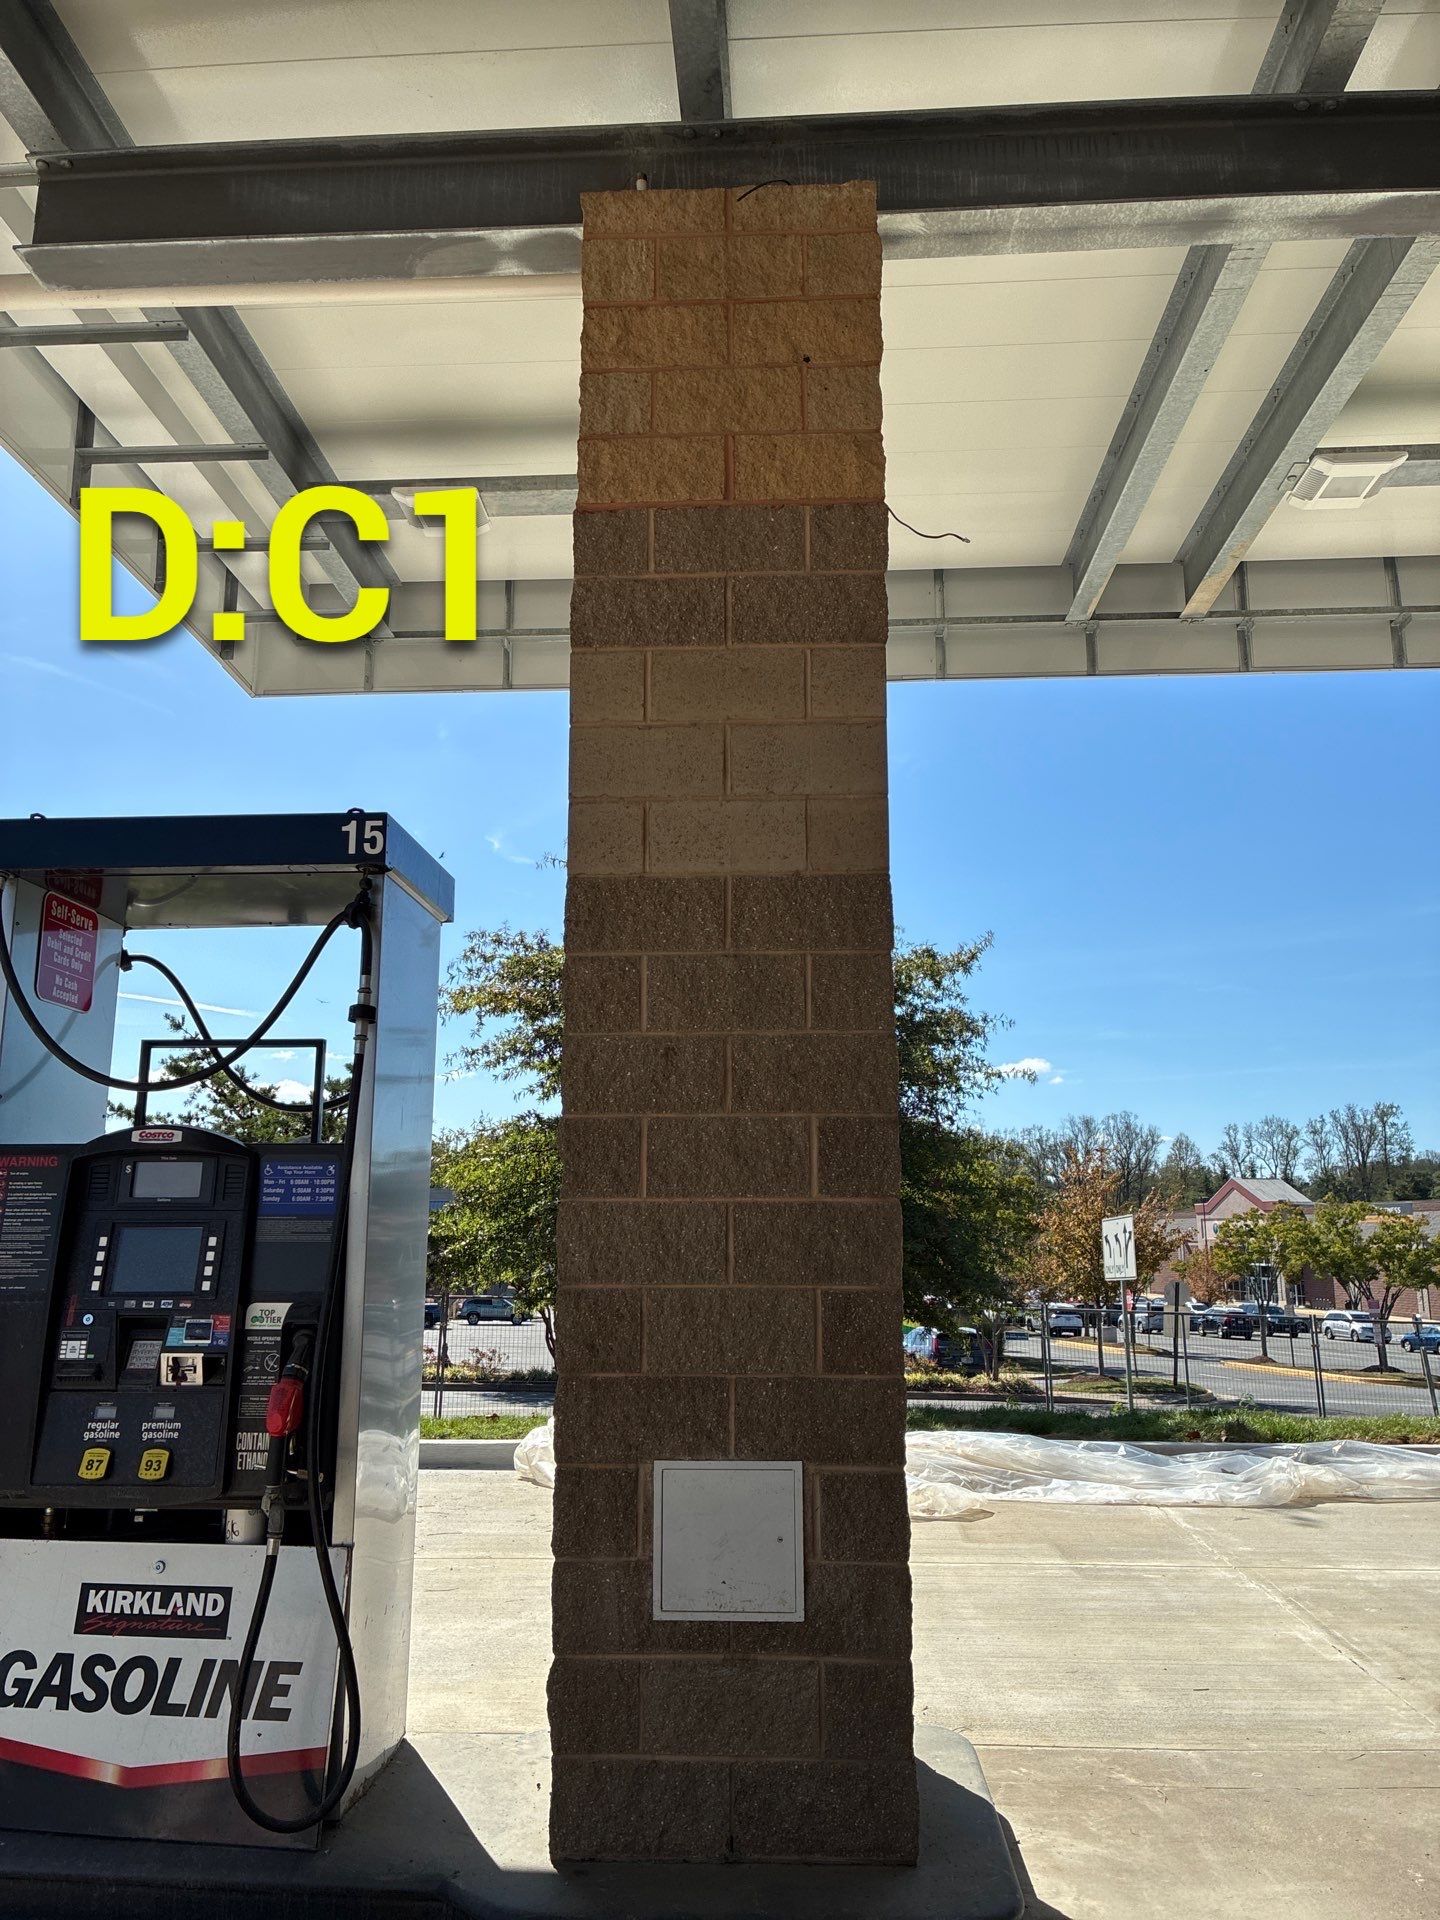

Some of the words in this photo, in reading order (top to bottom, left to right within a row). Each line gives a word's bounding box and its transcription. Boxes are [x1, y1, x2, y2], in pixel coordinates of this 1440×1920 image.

[341, 820, 384, 855] 15
[51, 900, 93, 931] Self-Serve
[58, 929, 83, 947] Selected
[47, 937, 62, 951] Debit
[63, 944, 73, 955] and
[75, 947, 92, 962] Credit
[53, 952, 69, 967] Cards
[70, 958, 83, 973] Only
[55, 973, 63, 987] No
[64, 977, 78, 991] Cash
[52, 986, 79, 1004] Accepted
[138, 1131, 175, 1139] COSTCO
[0, 1155, 58, 1168] WARNING
[259, 1309, 276, 1317] TOP
[265, 1316, 282, 1324] TIER
[87, 1420, 120, 1432] regular
[141, 1420, 182, 1432] premium
[83, 1430, 121, 1441] gasoline
[141, 1430, 179, 1442] gasoline
[236, 1432, 270, 1451] CONTAIN
[85, 1459, 104, 1472] 87
[144, 1459, 162, 1472] 93
[237, 1451, 269, 1471] ETHANO
[86, 1589, 225, 1617] KIRKLAND
[81, 1615, 222, 1637] Signature
[0, 1649, 304, 1722] GASOLINE
